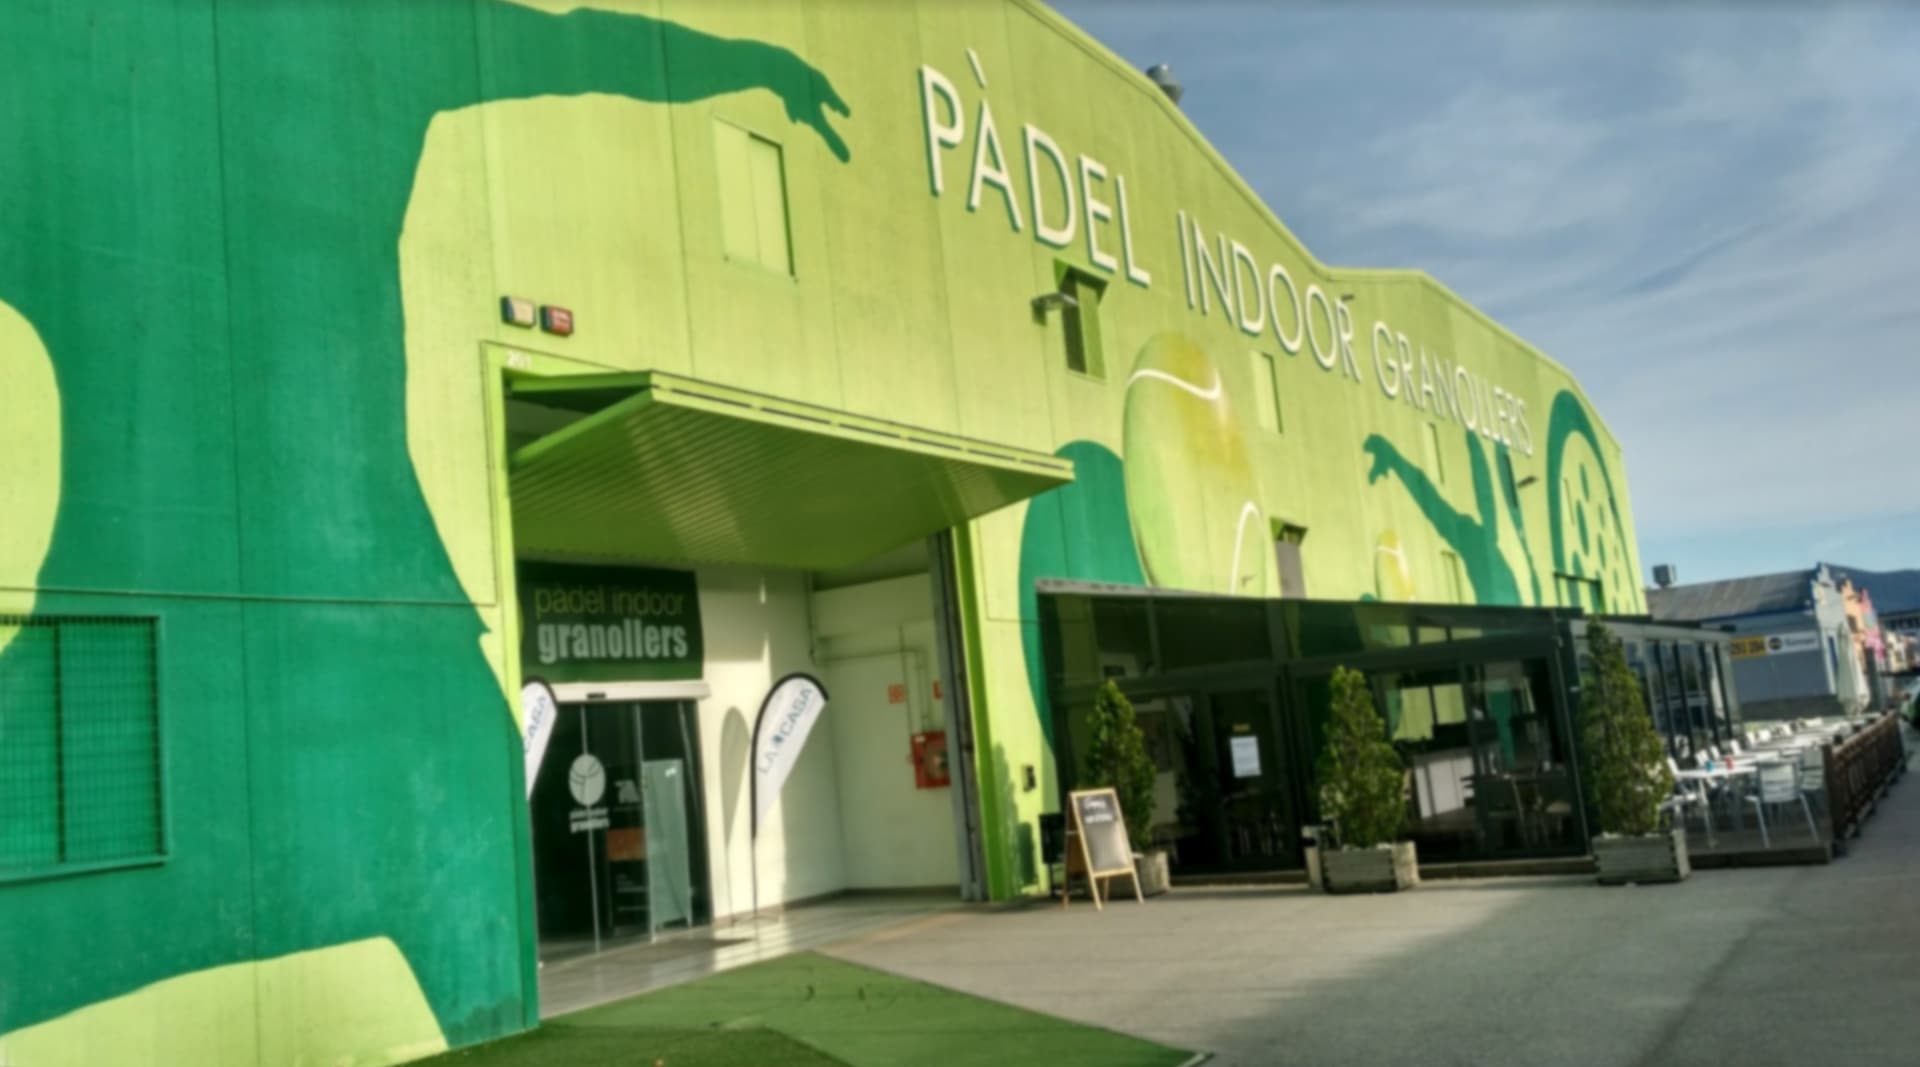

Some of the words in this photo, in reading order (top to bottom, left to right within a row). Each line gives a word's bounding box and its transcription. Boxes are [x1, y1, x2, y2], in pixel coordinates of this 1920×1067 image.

[919, 50, 1151, 286] PÀDEL
[1178, 210, 1360, 383] INDOOR
[1373, 321, 1533, 456] GRANOLLERS
[612, 585, 684, 616] indoor
[538, 619, 688, 664] granollers
